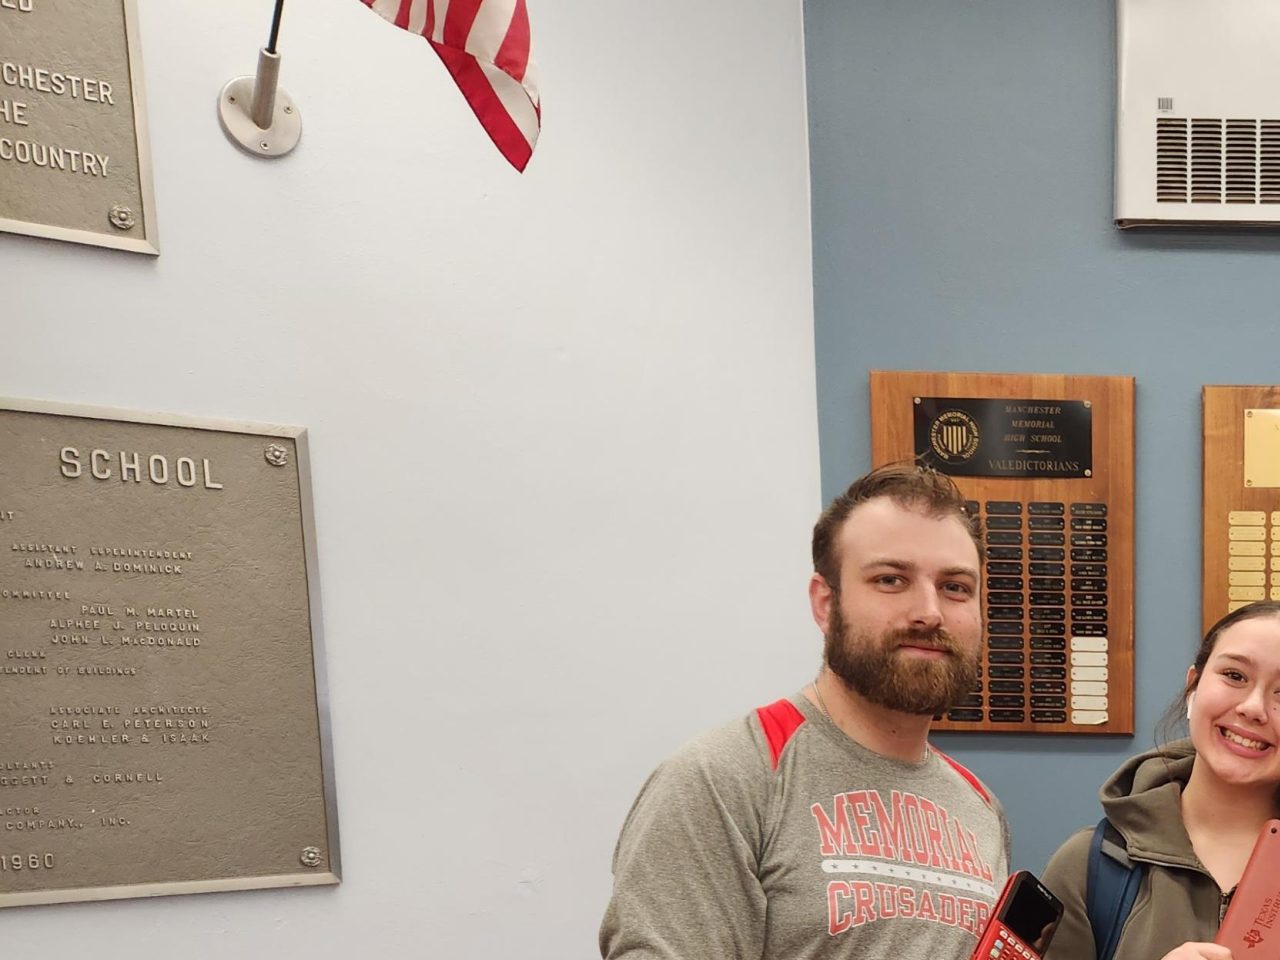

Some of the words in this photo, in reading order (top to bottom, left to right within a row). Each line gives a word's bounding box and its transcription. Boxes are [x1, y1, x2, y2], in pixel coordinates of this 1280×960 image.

[0, 138, 110, 177] COUNTRY
[1005, 405, 1062, 415] MANCHESTER
[1011, 420, 1055, 429] MEMORIAL
[1003, 434, 1026, 442] HIGH
[1030, 434, 1063, 443] SCHOOL
[59, 446, 224, 490] SCHOOL
[988, 459, 1080, 472] VALEDICTORIANS
[12, 543, 78, 554] ASSISTANT
[90, 547, 193, 560] SUPERINTENDENT
[25, 558, 84, 570] ANDREW
[113, 562, 183, 574] DOMINICK
[81, 605, 114, 616] PAUL
[147, 607, 199, 619] MARTEL
[50, 619, 101, 631] ALPHEE
[136, 621, 200, 633] PELOQUIN
[51, 634, 89, 645] JOHN
[56, 666, 71, 676] OF
[77, 666, 137, 677] BUILDINGS
[50, 706, 121, 716] ASSOCIATE
[133, 705, 210, 716] ARCHITECTS
[51, 719, 90, 729] CARL
[124, 718, 210, 729] PETERSON
[53, 734, 130, 745] KOEHLER
[140, 734, 150, 745] &
[162, 733, 210, 745] ISAAK
[65, 775, 75, 785] &
[92, 772, 164, 784] CORNELL
[101, 816, 132, 827] INC.
[811, 790, 994, 882] MEMORIAL
[0, 853, 54, 871] 1960
[827, 880, 997, 938] CRUSADER
